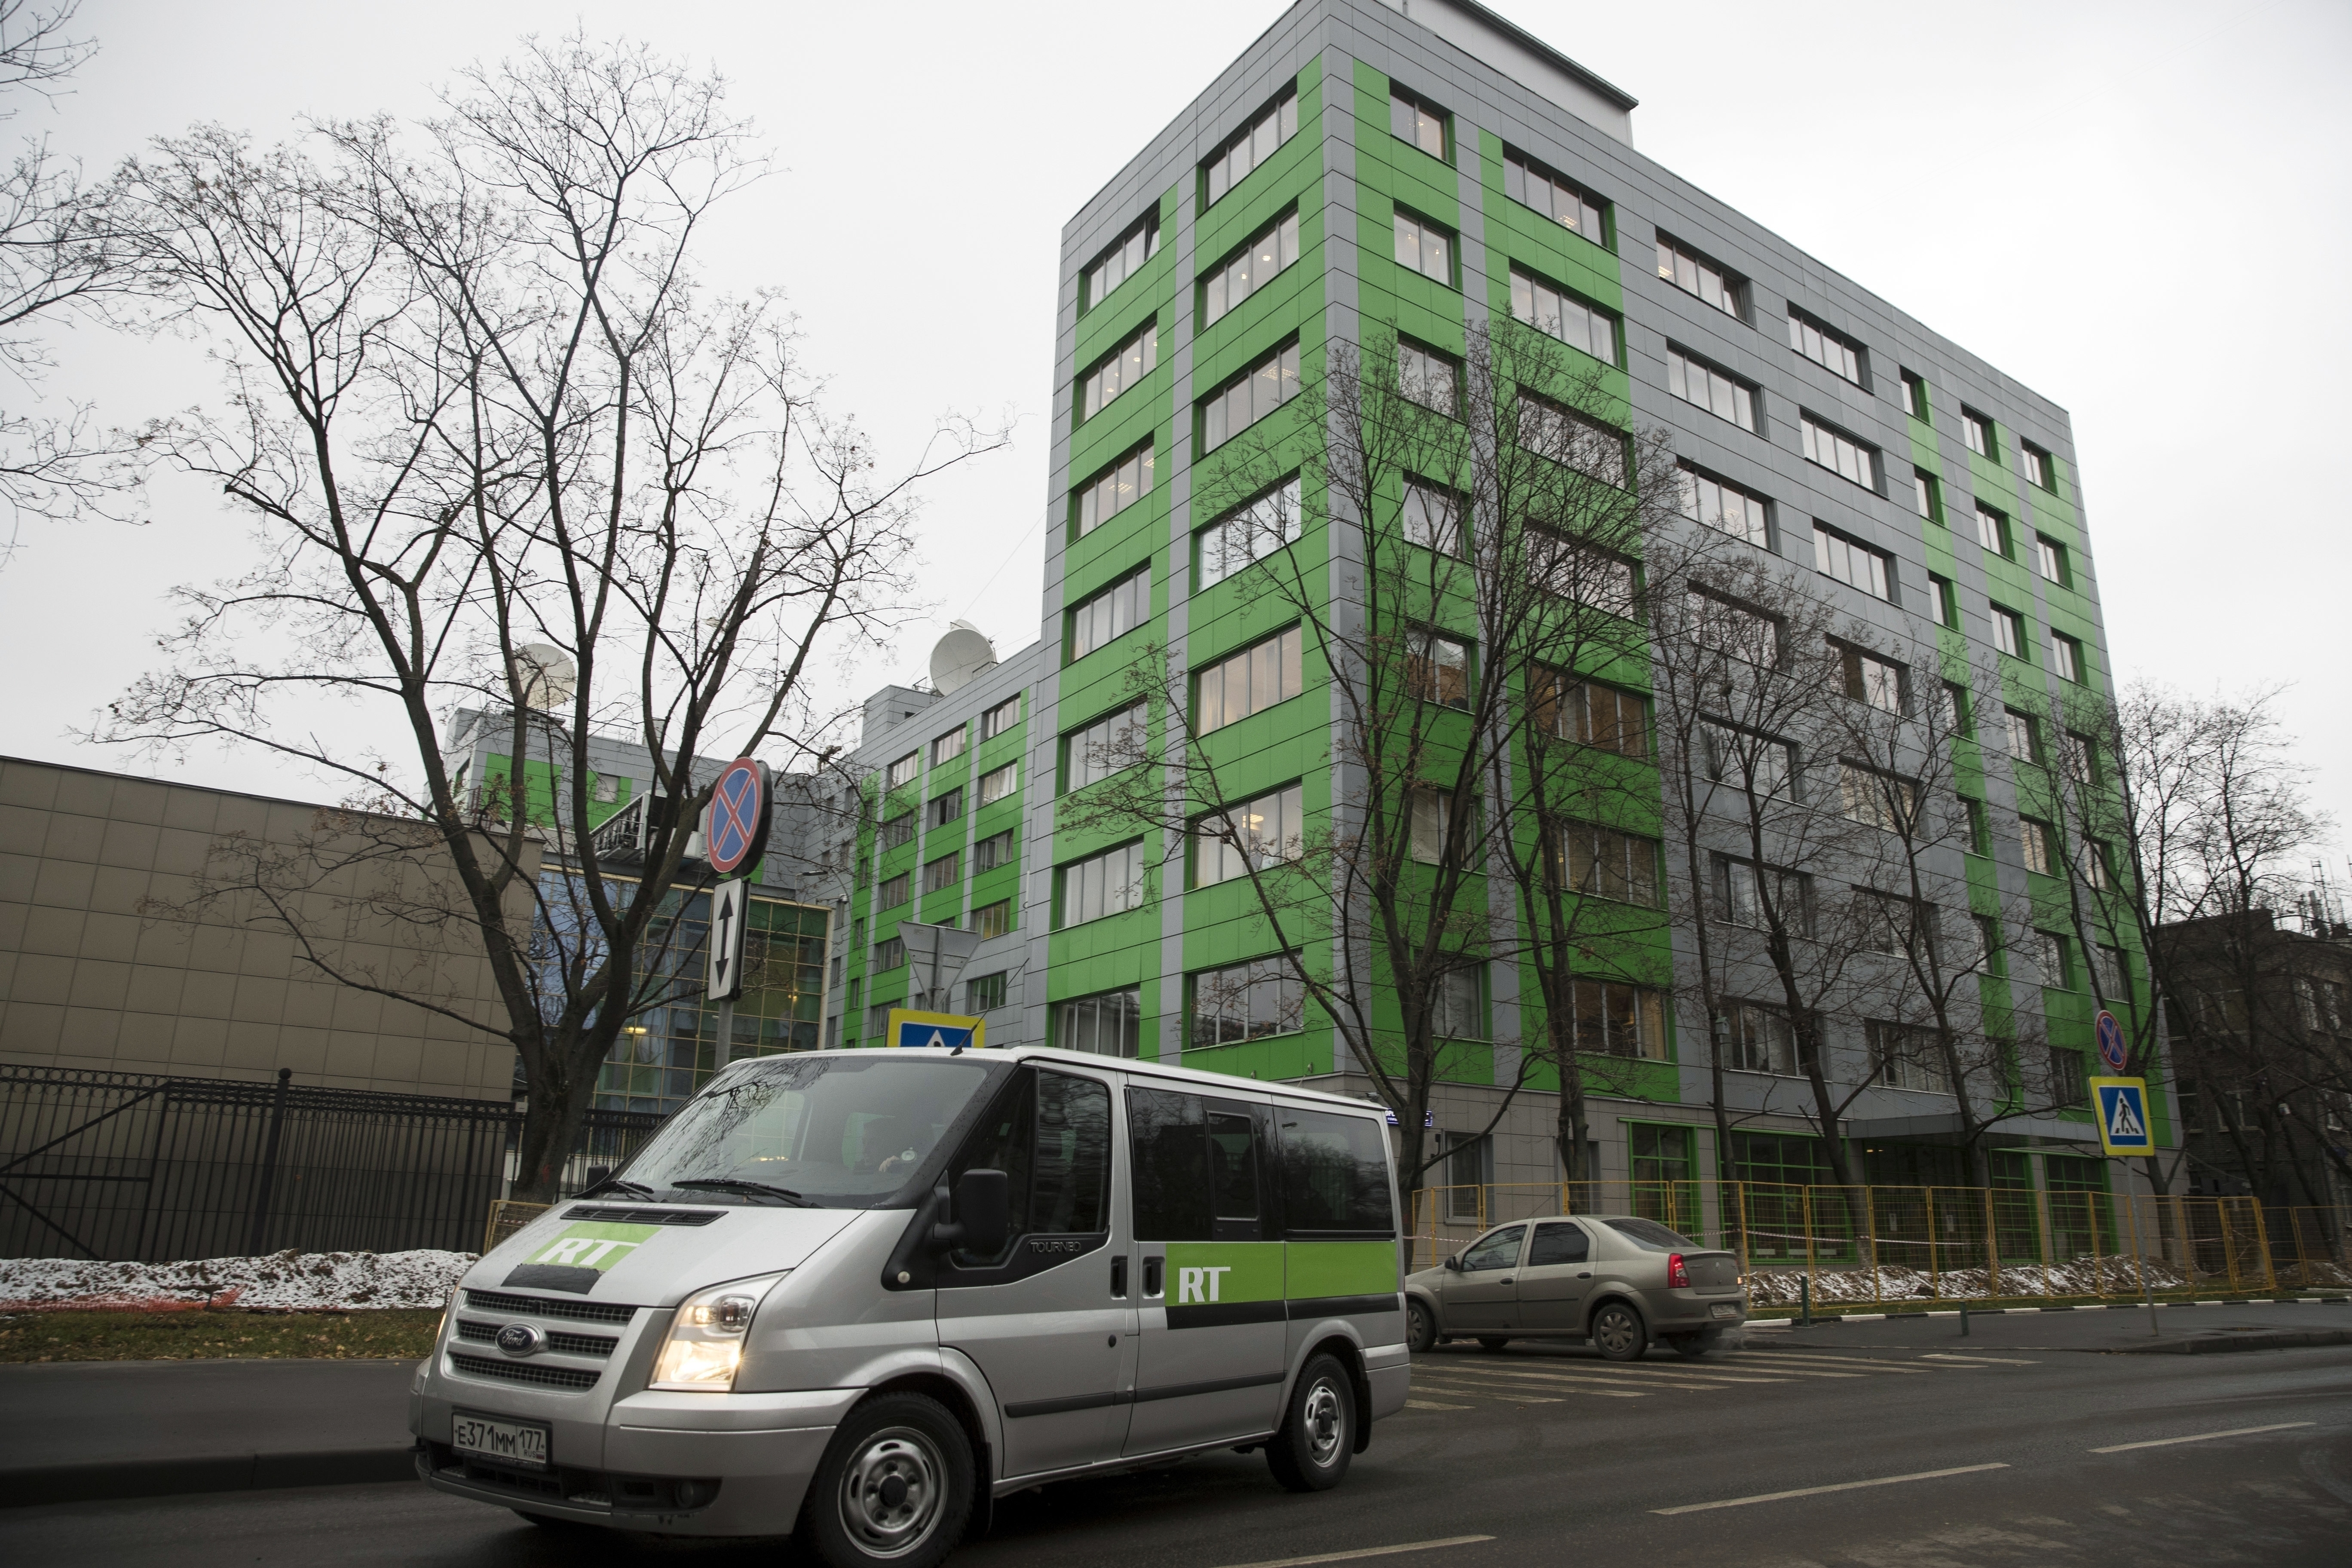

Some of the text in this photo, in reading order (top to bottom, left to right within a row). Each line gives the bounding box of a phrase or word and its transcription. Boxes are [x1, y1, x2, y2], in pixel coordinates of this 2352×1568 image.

[536, 1237, 641, 1265] RT
[1030, 1241, 1081, 1253] TOURNEO
[1179, 1266, 1231, 1303] RT
[502, 1329, 527, 1346] Ford
[519, 1428, 542, 1451] 177
[524, 1449, 536, 1458] RUS
